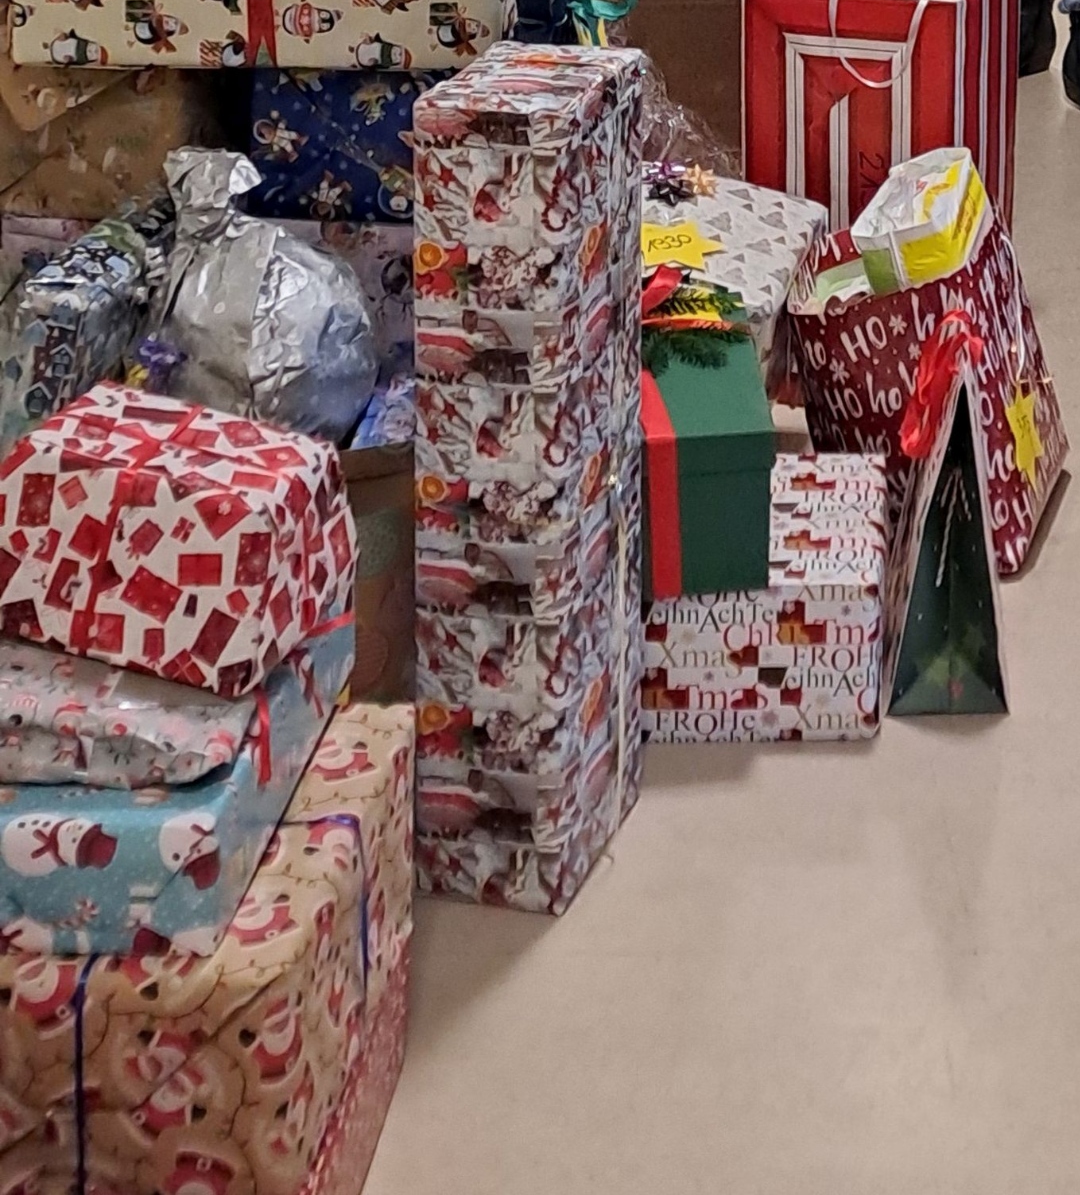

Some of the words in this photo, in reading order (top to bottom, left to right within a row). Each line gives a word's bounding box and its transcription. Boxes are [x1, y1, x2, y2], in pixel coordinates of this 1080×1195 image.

[840, 316, 887, 363] HO
[824, 387, 863, 421] HO
[866, 371, 902, 418] ho
